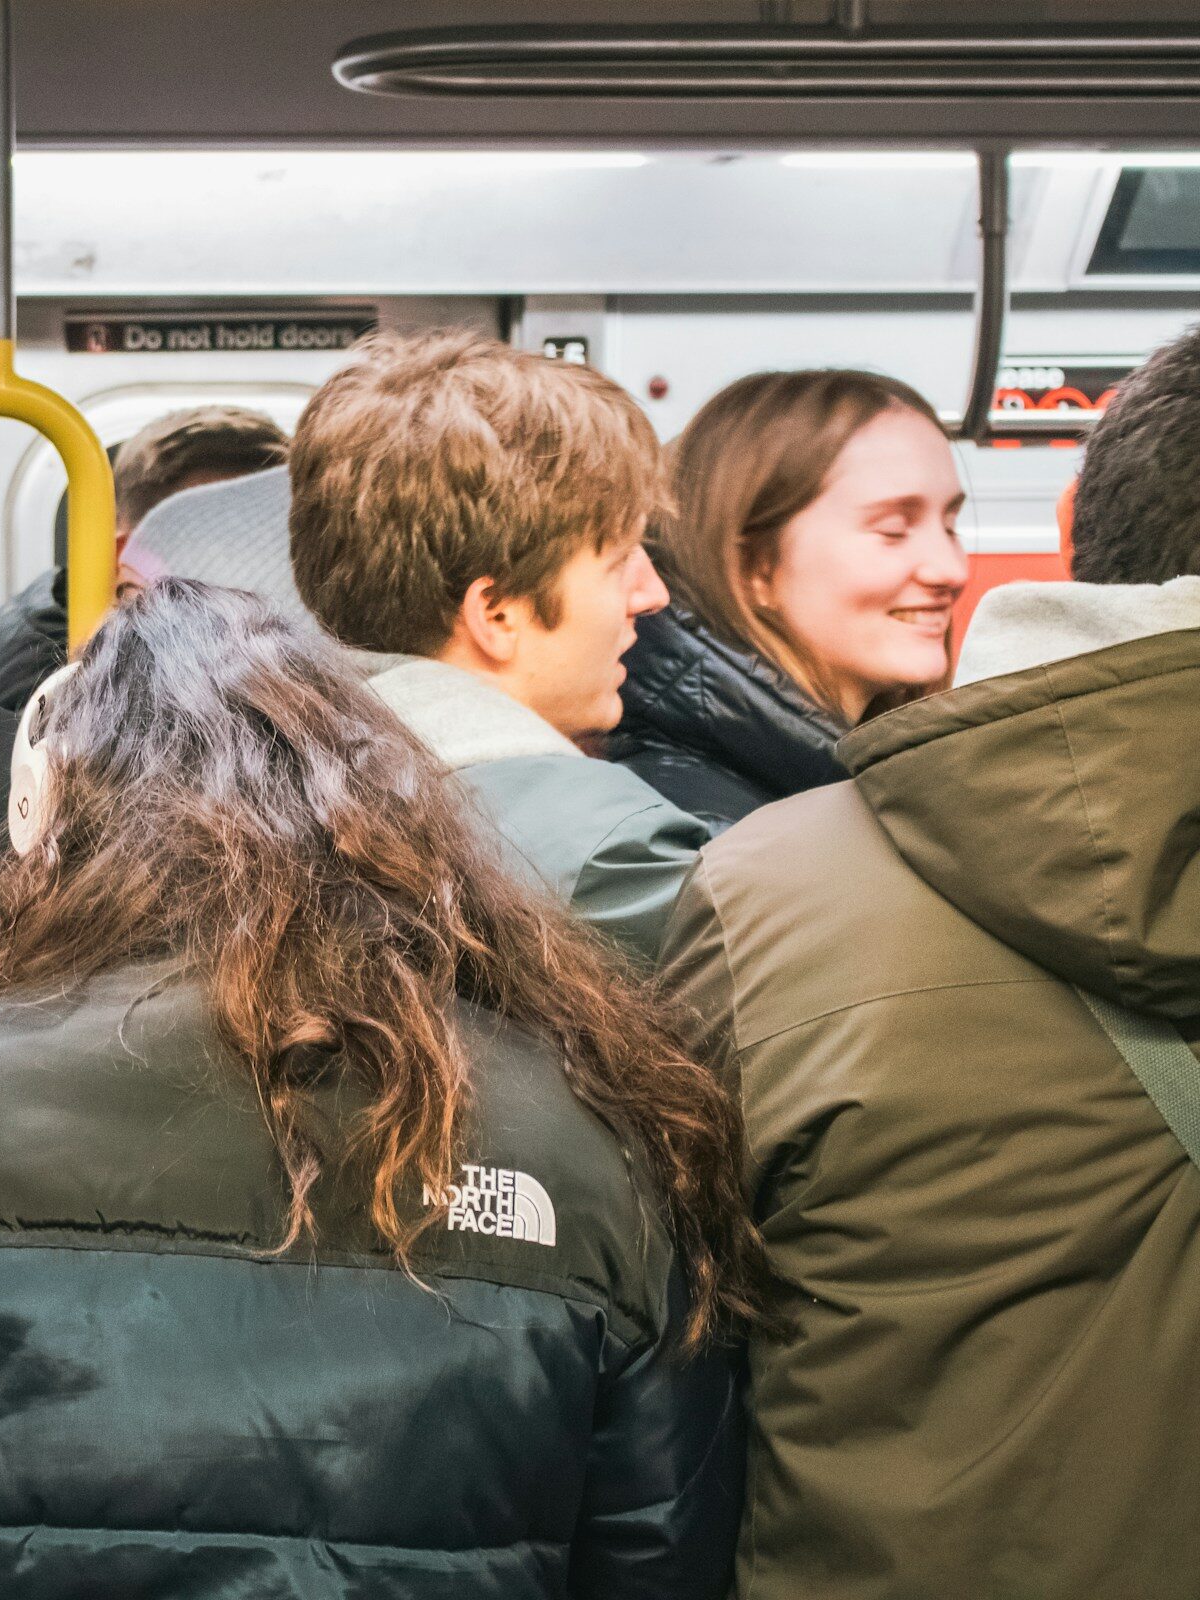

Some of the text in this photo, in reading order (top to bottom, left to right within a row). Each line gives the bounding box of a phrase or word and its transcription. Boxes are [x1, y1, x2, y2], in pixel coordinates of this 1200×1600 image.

[125, 325, 162, 349] Do
[168, 326, 210, 349] not
[216, 324, 274, 348] hold
[461, 1164, 514, 1192] THE
[422, 1182, 515, 1215] NORTH
[447, 1207, 514, 1238] FACE
